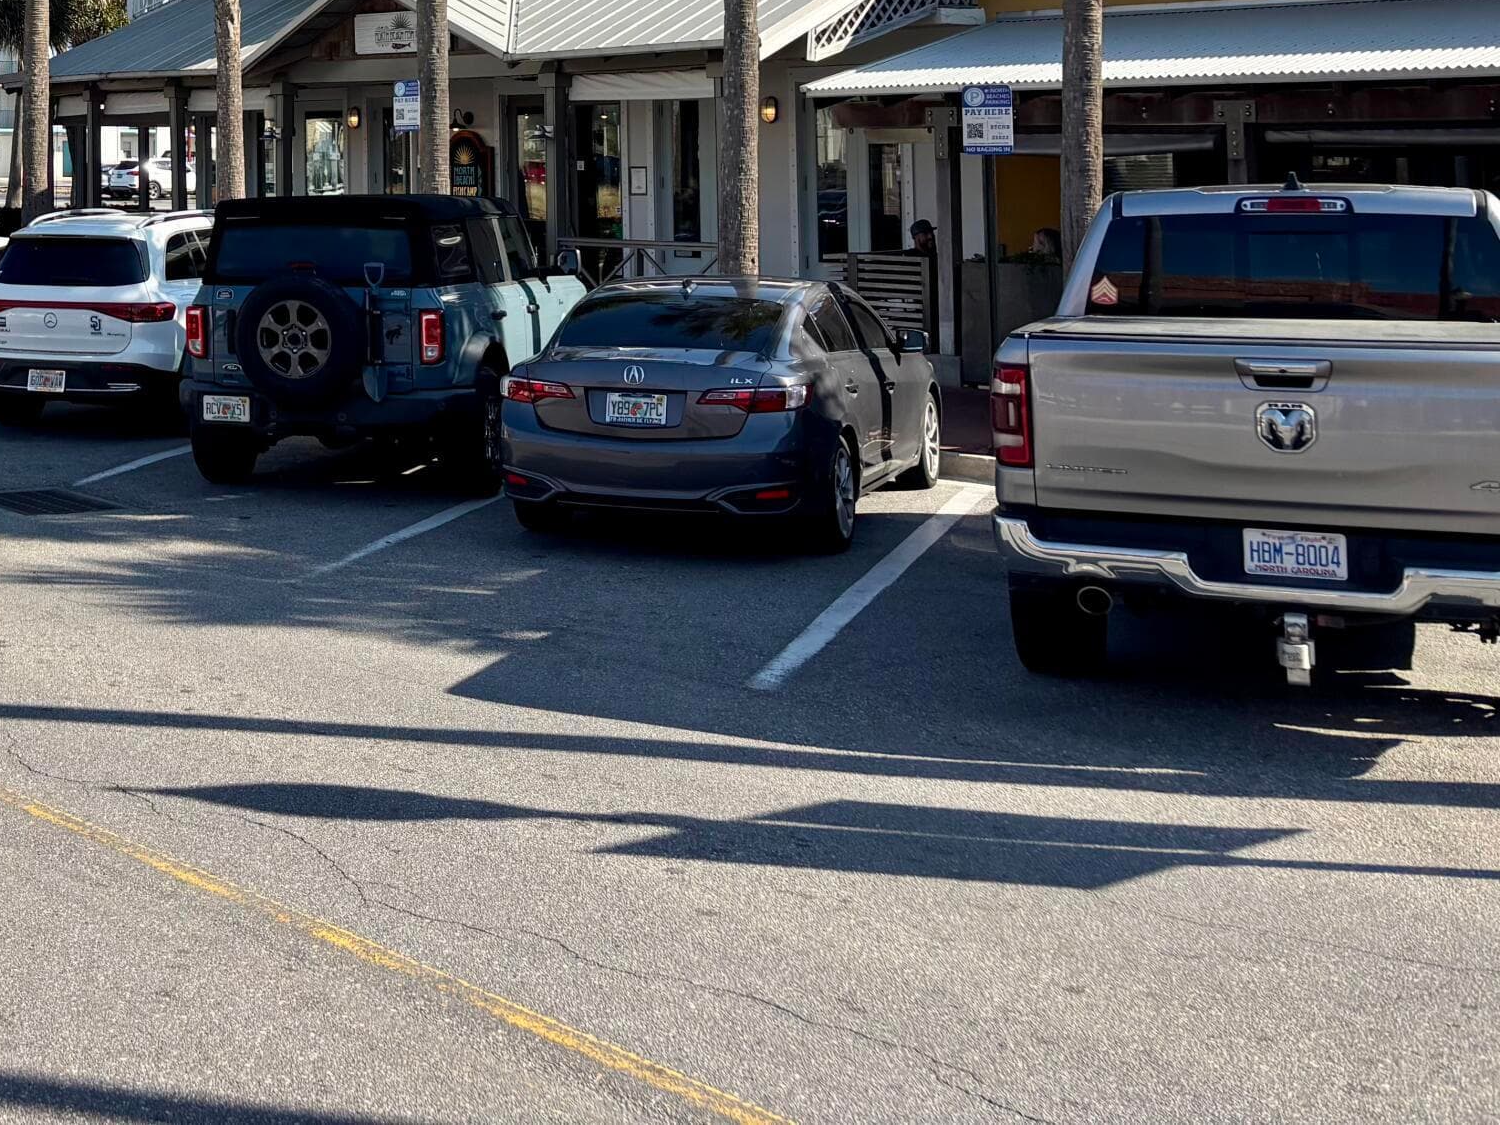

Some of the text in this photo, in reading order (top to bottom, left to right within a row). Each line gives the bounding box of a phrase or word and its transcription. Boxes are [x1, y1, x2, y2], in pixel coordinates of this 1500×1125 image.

[1249, 539, 1341, 568] HBM-8004
[1254, 563, 1338, 578] NORTH CAROLINA
